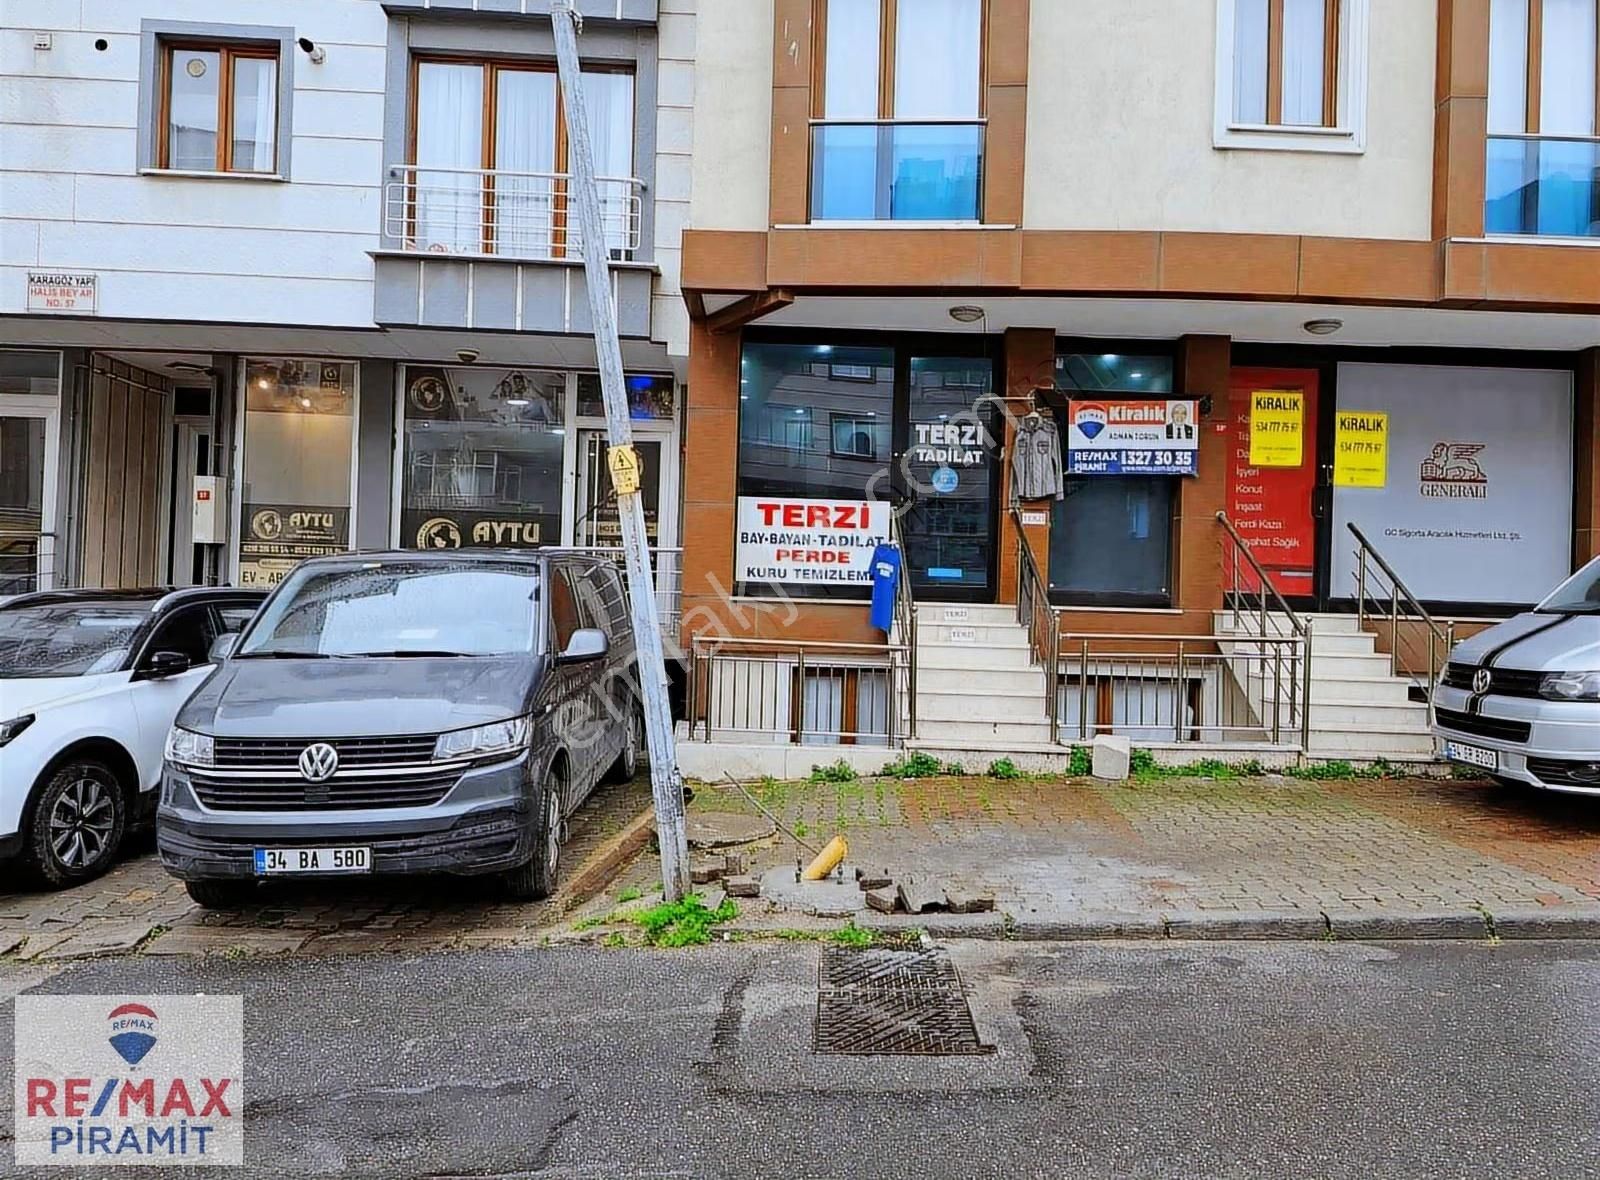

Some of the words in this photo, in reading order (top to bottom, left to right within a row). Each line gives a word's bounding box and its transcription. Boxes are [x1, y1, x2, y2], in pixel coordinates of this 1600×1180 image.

[915, 422, 983, 445] TERZİ
[916, 448, 983, 463] TADİLAT
[1074, 451, 1118, 462] RE/MAX
[1154, 451, 1172, 465] 30
[1175, 451, 1192, 465] 35
[1236, 484, 1263, 493] Konut
[289, 512, 334, 527] AYTU
[757, 502, 870, 529] TERZİ
[472, 521, 540, 544] AYTU
[776, 548, 850, 563] PERDE
[242, 571, 257, 582] EV
[747, 567, 787, 579] KURU
[267, 851, 287, 869] 34
[299, 851, 319, 868] BA
[333, 849, 365, 867] 580
